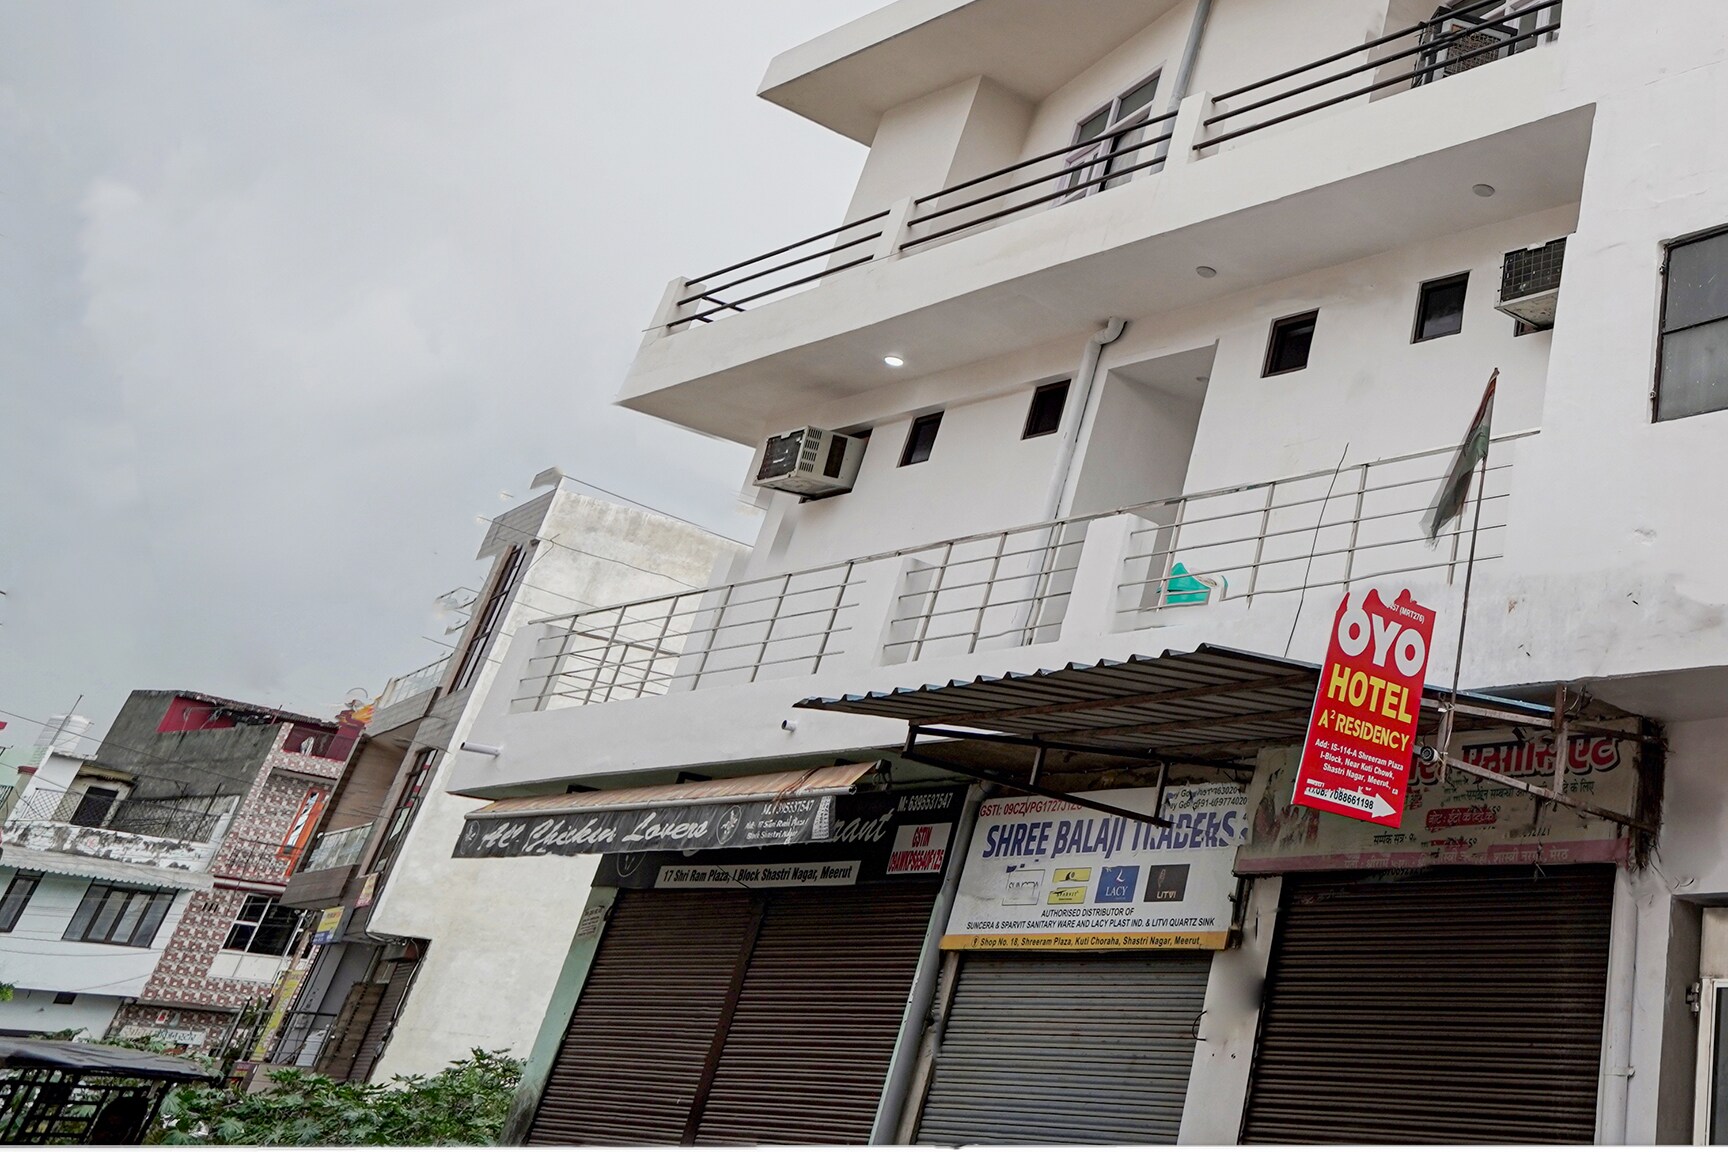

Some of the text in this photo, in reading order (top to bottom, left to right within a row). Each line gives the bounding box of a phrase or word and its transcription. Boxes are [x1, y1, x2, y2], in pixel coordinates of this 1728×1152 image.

[1338, 606, 1426, 677] OYO
[1327, 663, 1413, 724] HOTEL
[1335, 715, 1410, 752] RESIDENCY
[1314, 738, 1330, 750] Add:
[1358, 750, 1387, 767] Shreeram
[1387, 759, 1404, 771] Plaza
[1344, 757, 1361, 769] Near
[1322, 762, 1345, 775] Shastri
[907, 792, 954, 811] 6395537547
[982, 820, 1053, 859] SHREE
[1051, 817, 1127, 860] BALAJI
[663, 869, 672, 882] 17
[673, 868, 690, 882] Shri
[690, 867, 708, 881] Ram
[738, 865, 760, 881] Block
[761, 865, 791, 881] Shastri
[791, 864, 818, 882] Nagar,
[820, 863, 852, 879] Meerut
[1105, 885, 1128, 897] LACY
[1041, 907, 1135, 918] AUTHORISED DISTRIBUTOR OF
[1026, 920, 1057, 929] SANITARY
[1056, 920, 1076, 928] WARE
[1076, 920, 1090, 928] AND
[1090, 919, 1109, 928] LACY
[1109, 919, 1131, 928] PLAST
[1169, 918, 1198, 927] QUARTZ
[1198, 917, 1215, 926] SINK
[980, 937, 998, 948] Shop
[1021, 936, 1052, 946] Shreeram
[1053, 936, 1073, 947] Plaza,
[1075, 936, 1089, 945] Kuti
[1090, 935, 1120, 946] Choraha,
[1122, 935, 1149, 945] Shastri
[1150, 935, 1172, 947] Nagar,
[1174, 935, 1200, 945] Meerut
